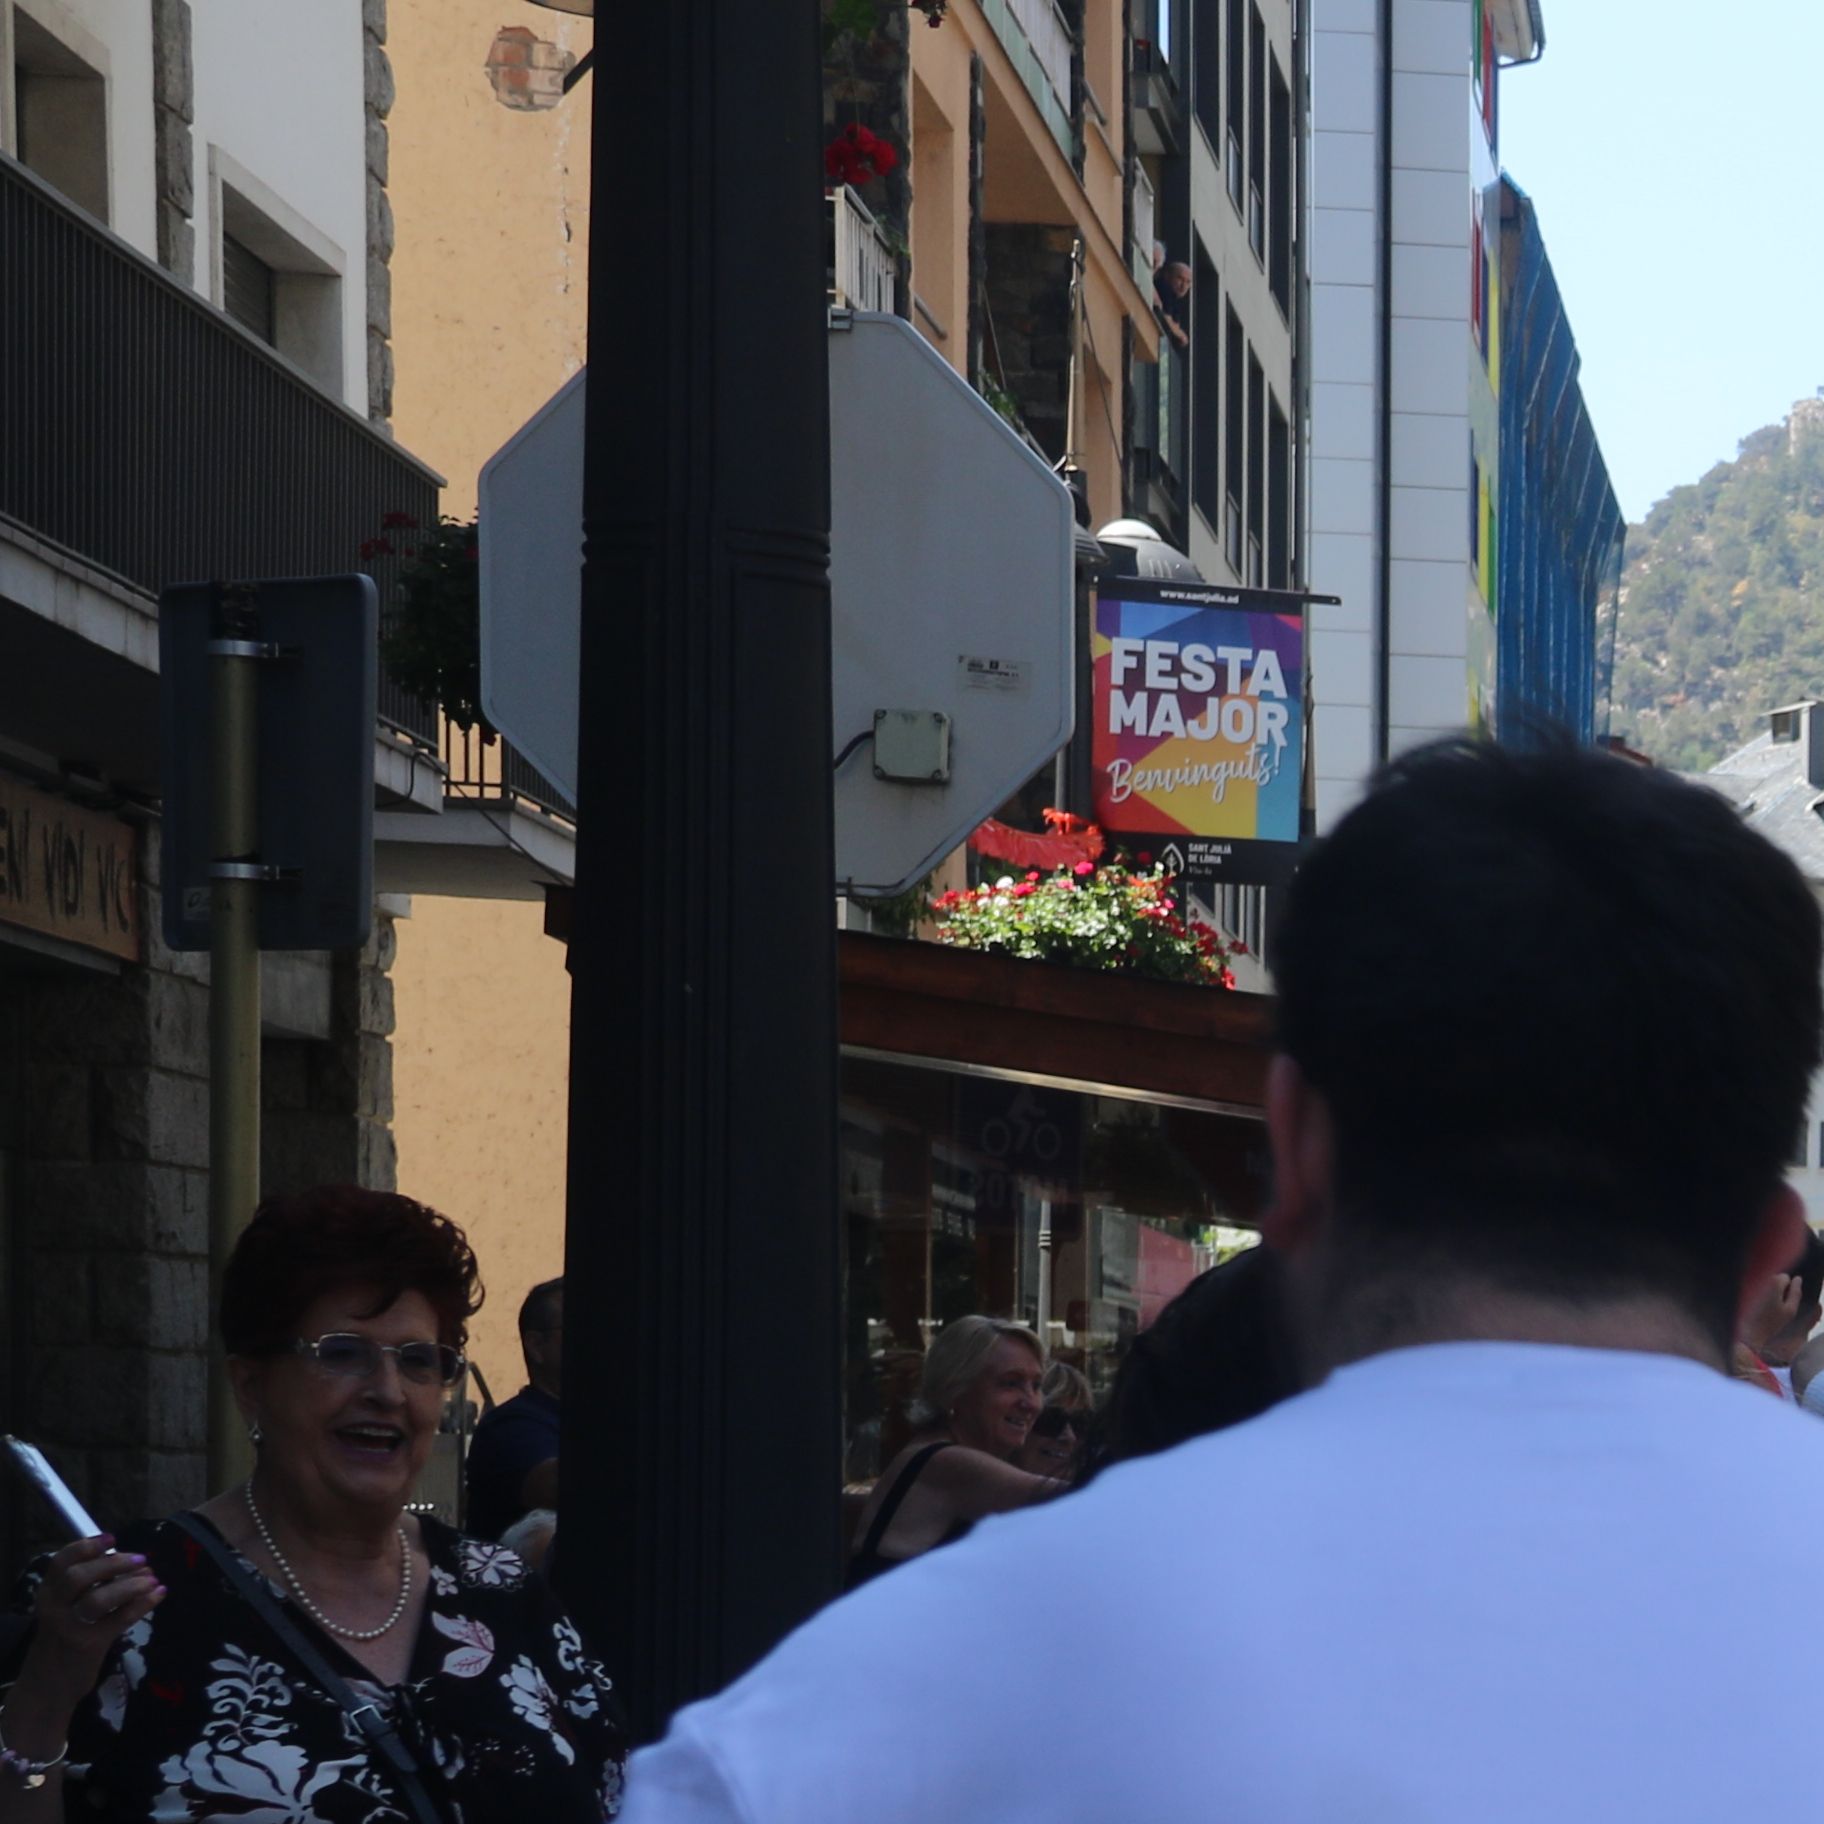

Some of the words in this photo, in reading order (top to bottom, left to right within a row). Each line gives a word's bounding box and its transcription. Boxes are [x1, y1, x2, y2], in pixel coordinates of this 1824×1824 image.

[1110, 636, 1288, 698] FESTA
[1108, 689, 1288, 748] MAJOR
[1106, 742, 1282, 804] Benvinguts!
